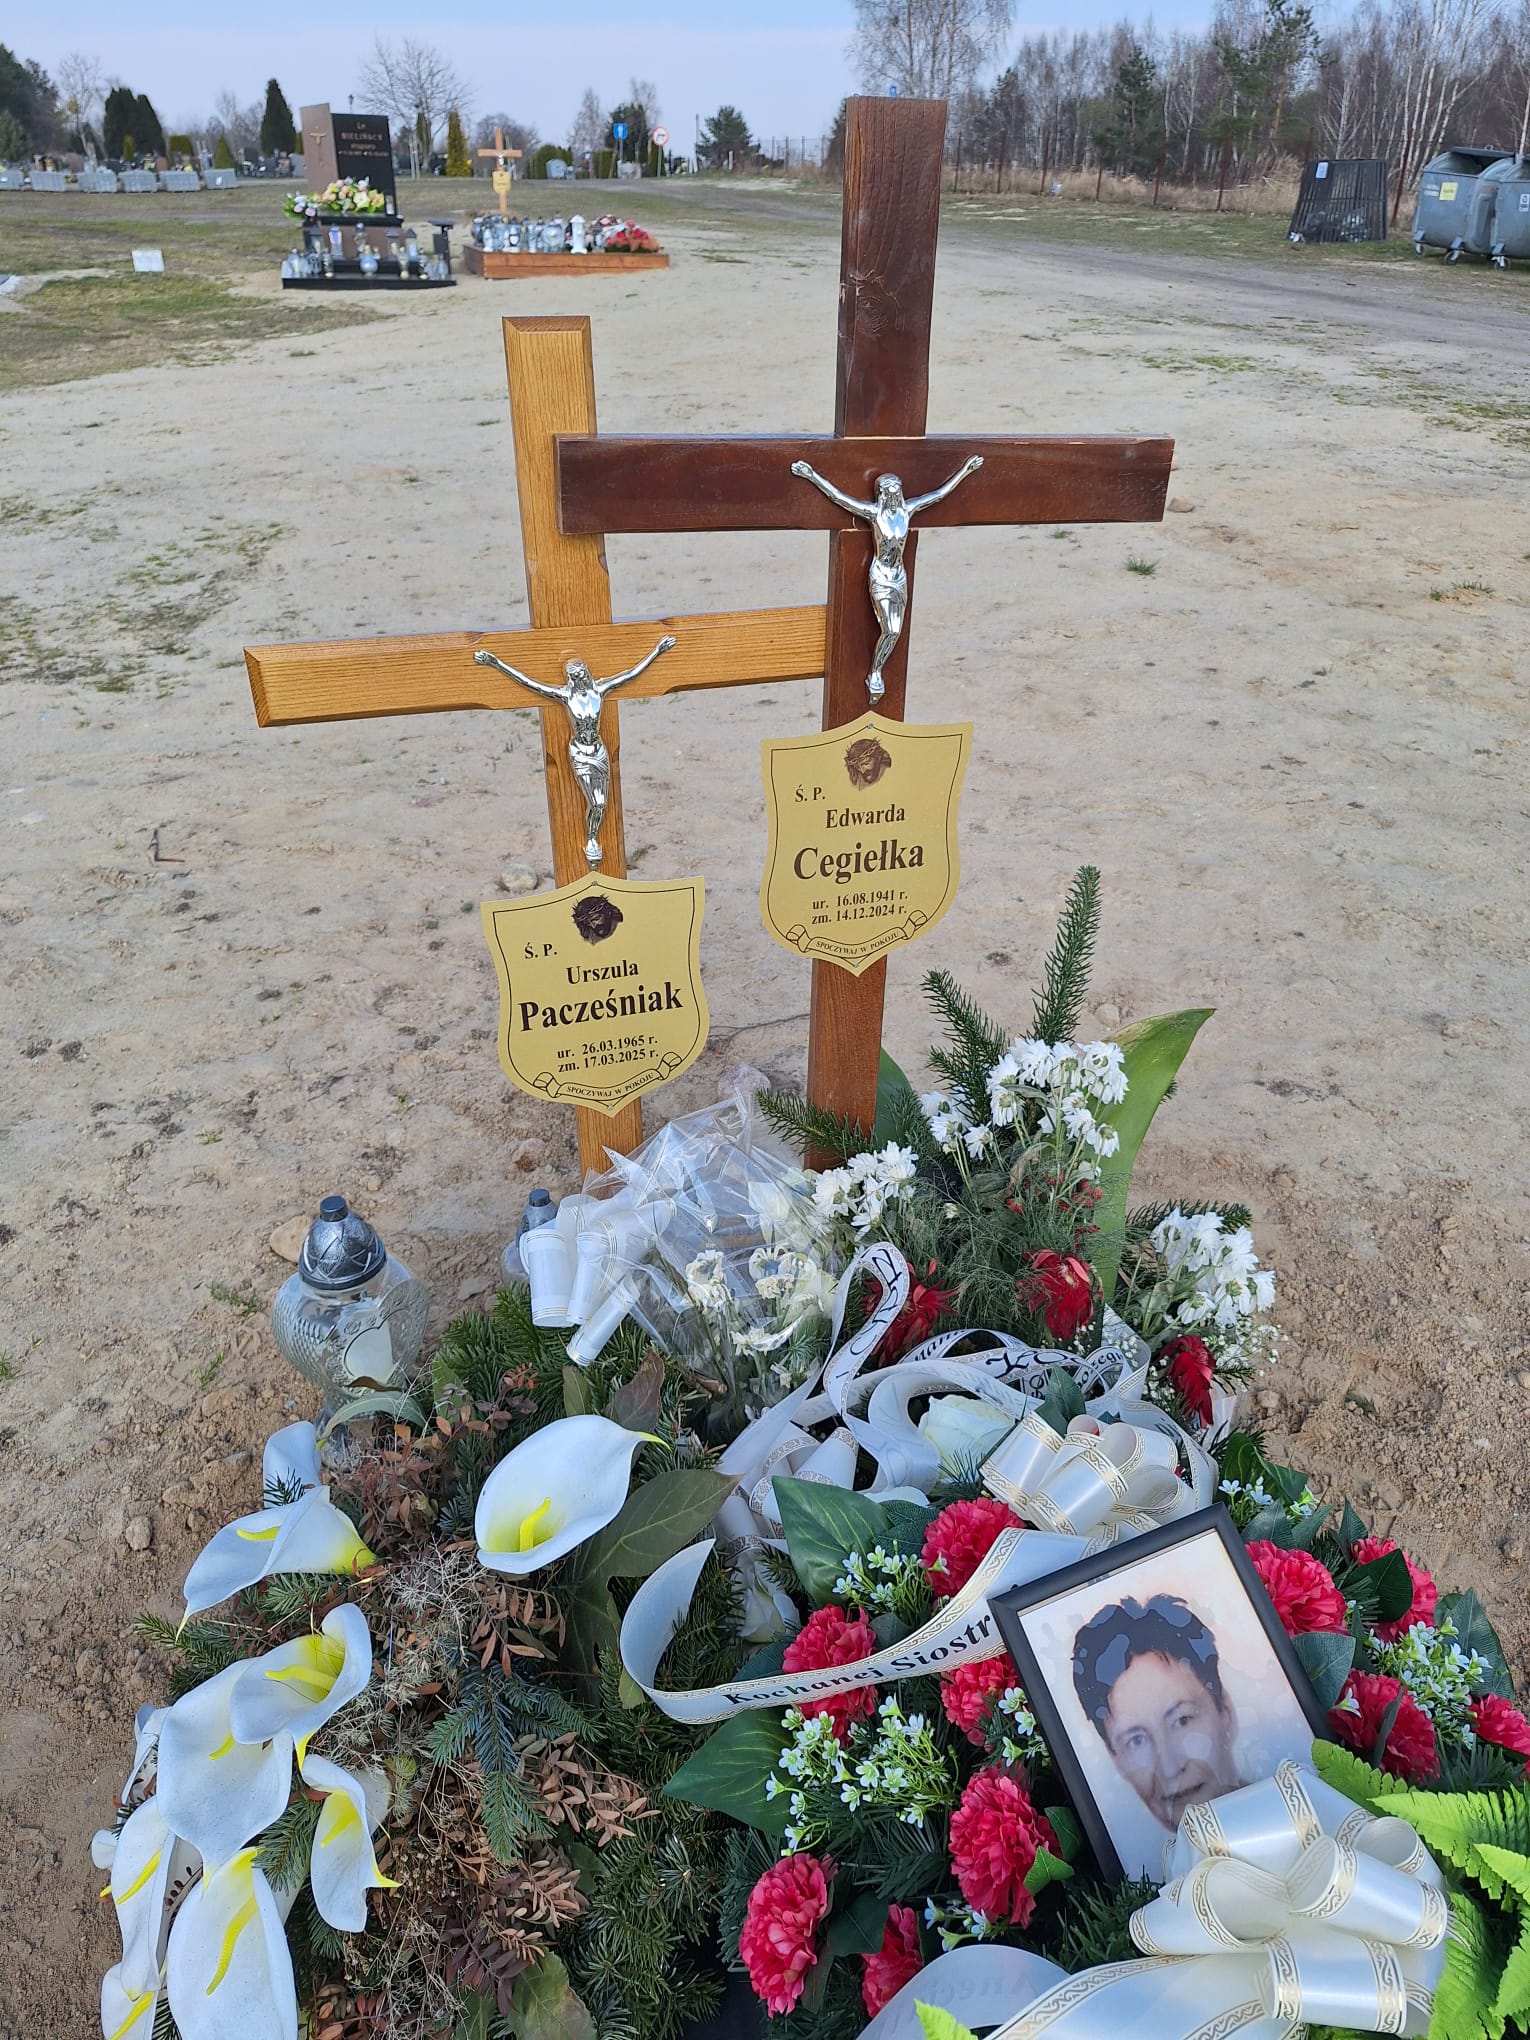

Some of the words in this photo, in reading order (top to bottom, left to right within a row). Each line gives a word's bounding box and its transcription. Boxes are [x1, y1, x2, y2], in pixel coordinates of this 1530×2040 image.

[794, 784, 808, 803] Ś.
[813, 786, 826, 801] P.
[825, 803, 905, 829] Edwarda
[793, 839, 924, 884] Cegiełka
[812, 898, 829, 910] ur.
[836, 889, 895, 907] 16.08.1941
[898, 889, 908, 900] r.
[811, 913, 832, 925] zm.
[835, 904, 895, 922] 14.12.2024
[898, 904, 907, 914] r.
[524, 942, 539, 959] Ś.
[543, 943, 557, 957] P.
[816, 941, 857, 954] SPOCZYWAJ
[860, 945, 867, 954] W
[870, 932, 900, 950] POKOJU
[566, 960, 639, 984] Urszula
[518, 981, 683, 1032] Pacześniak
[557, 1048, 575, 1059] ur.
[581, 1035, 645, 1055] 26.03.1965
[648, 1036, 658, 1045] r.
[558, 1061, 580, 1073] zm.
[583, 1048, 646, 1068] 17.03.2025
[649, 1049, 659, 1059] r.
[566, 1086, 612, 1097] SPOCZYWAJ
[624, 1073, 655, 1092] POKOJU
[722, 1667, 883, 1704] Kochanej
[889, 1614, 991, 1673] Siostr
